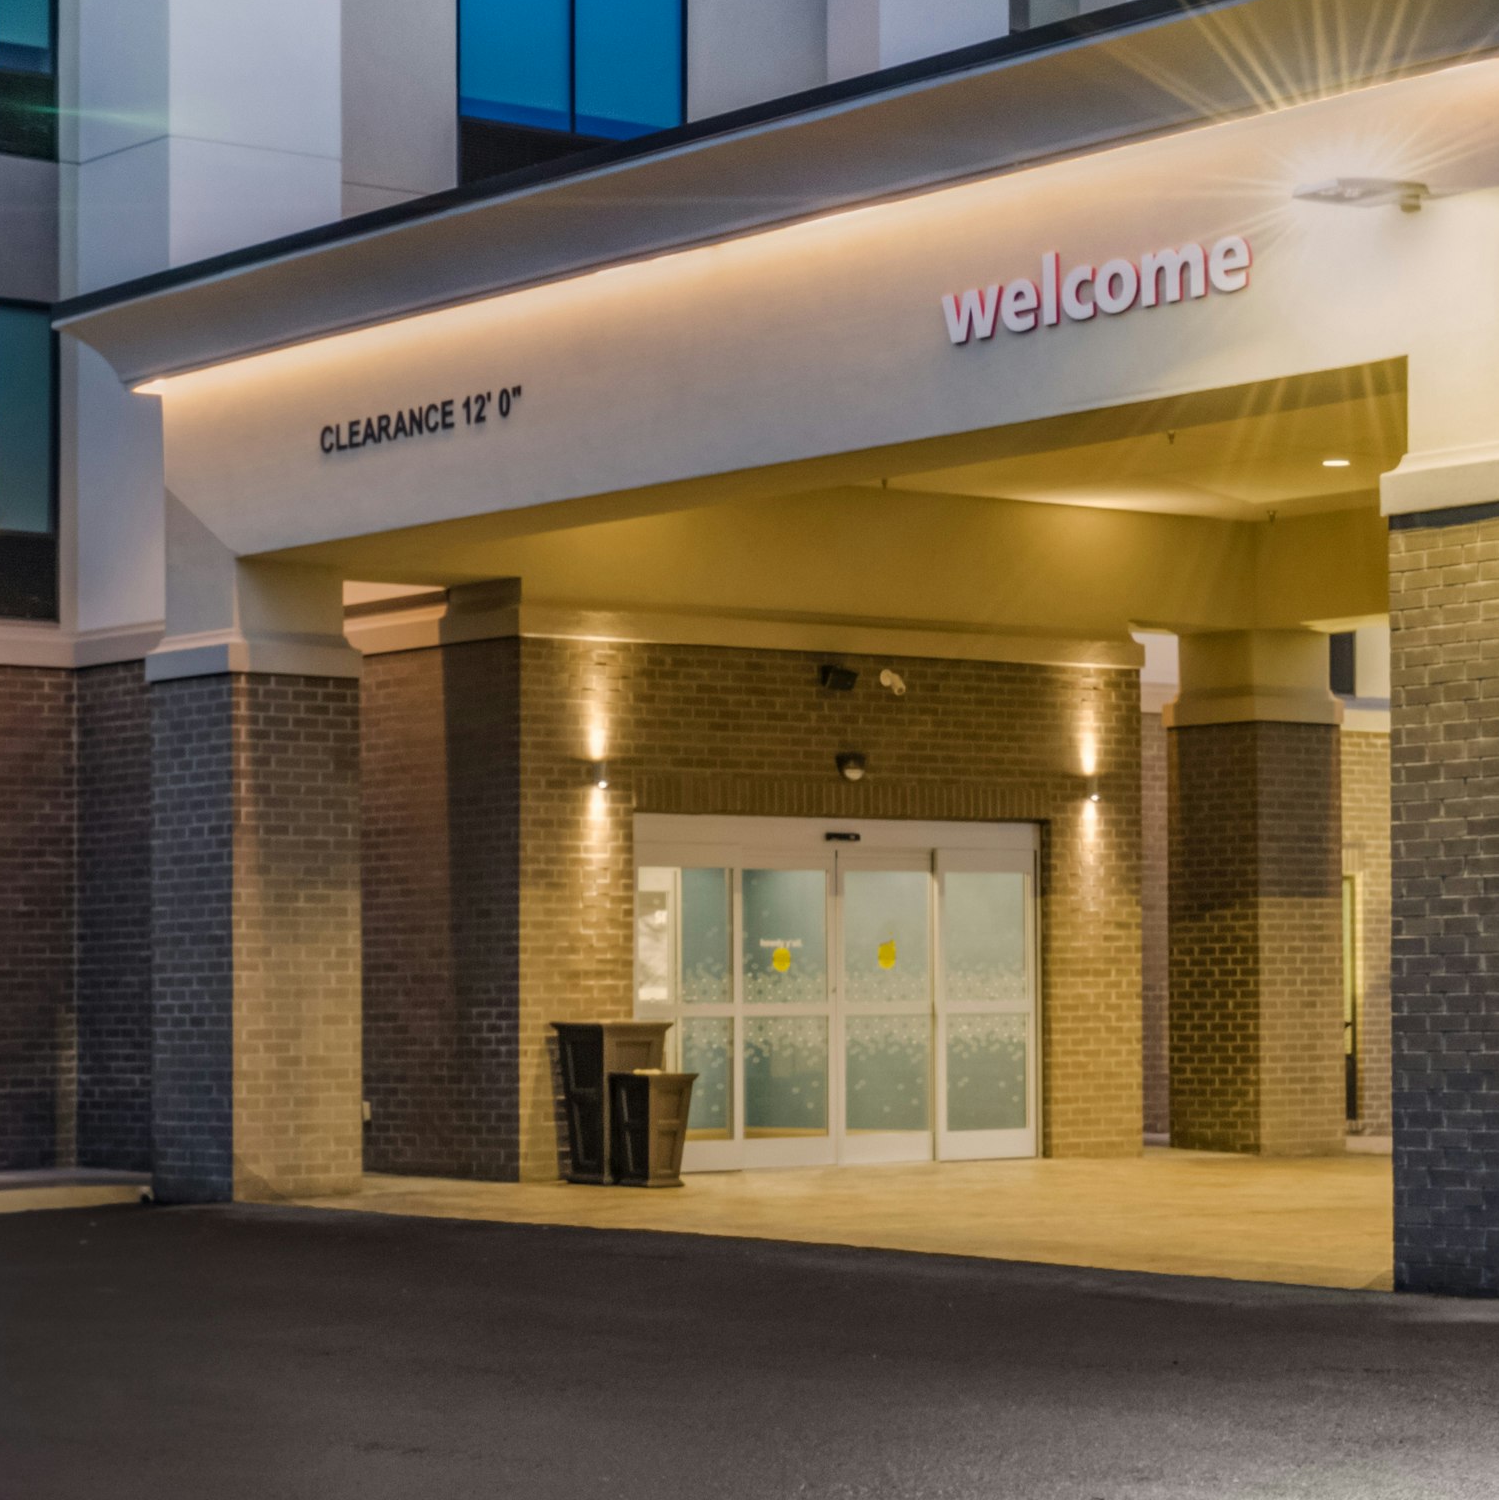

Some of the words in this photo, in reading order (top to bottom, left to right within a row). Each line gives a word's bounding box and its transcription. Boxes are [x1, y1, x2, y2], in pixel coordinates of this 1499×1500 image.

[942, 235, 1252, 344] welcome
[320, 399, 455, 453] CLEARANCE
[462, 391, 491, 425] 12'
